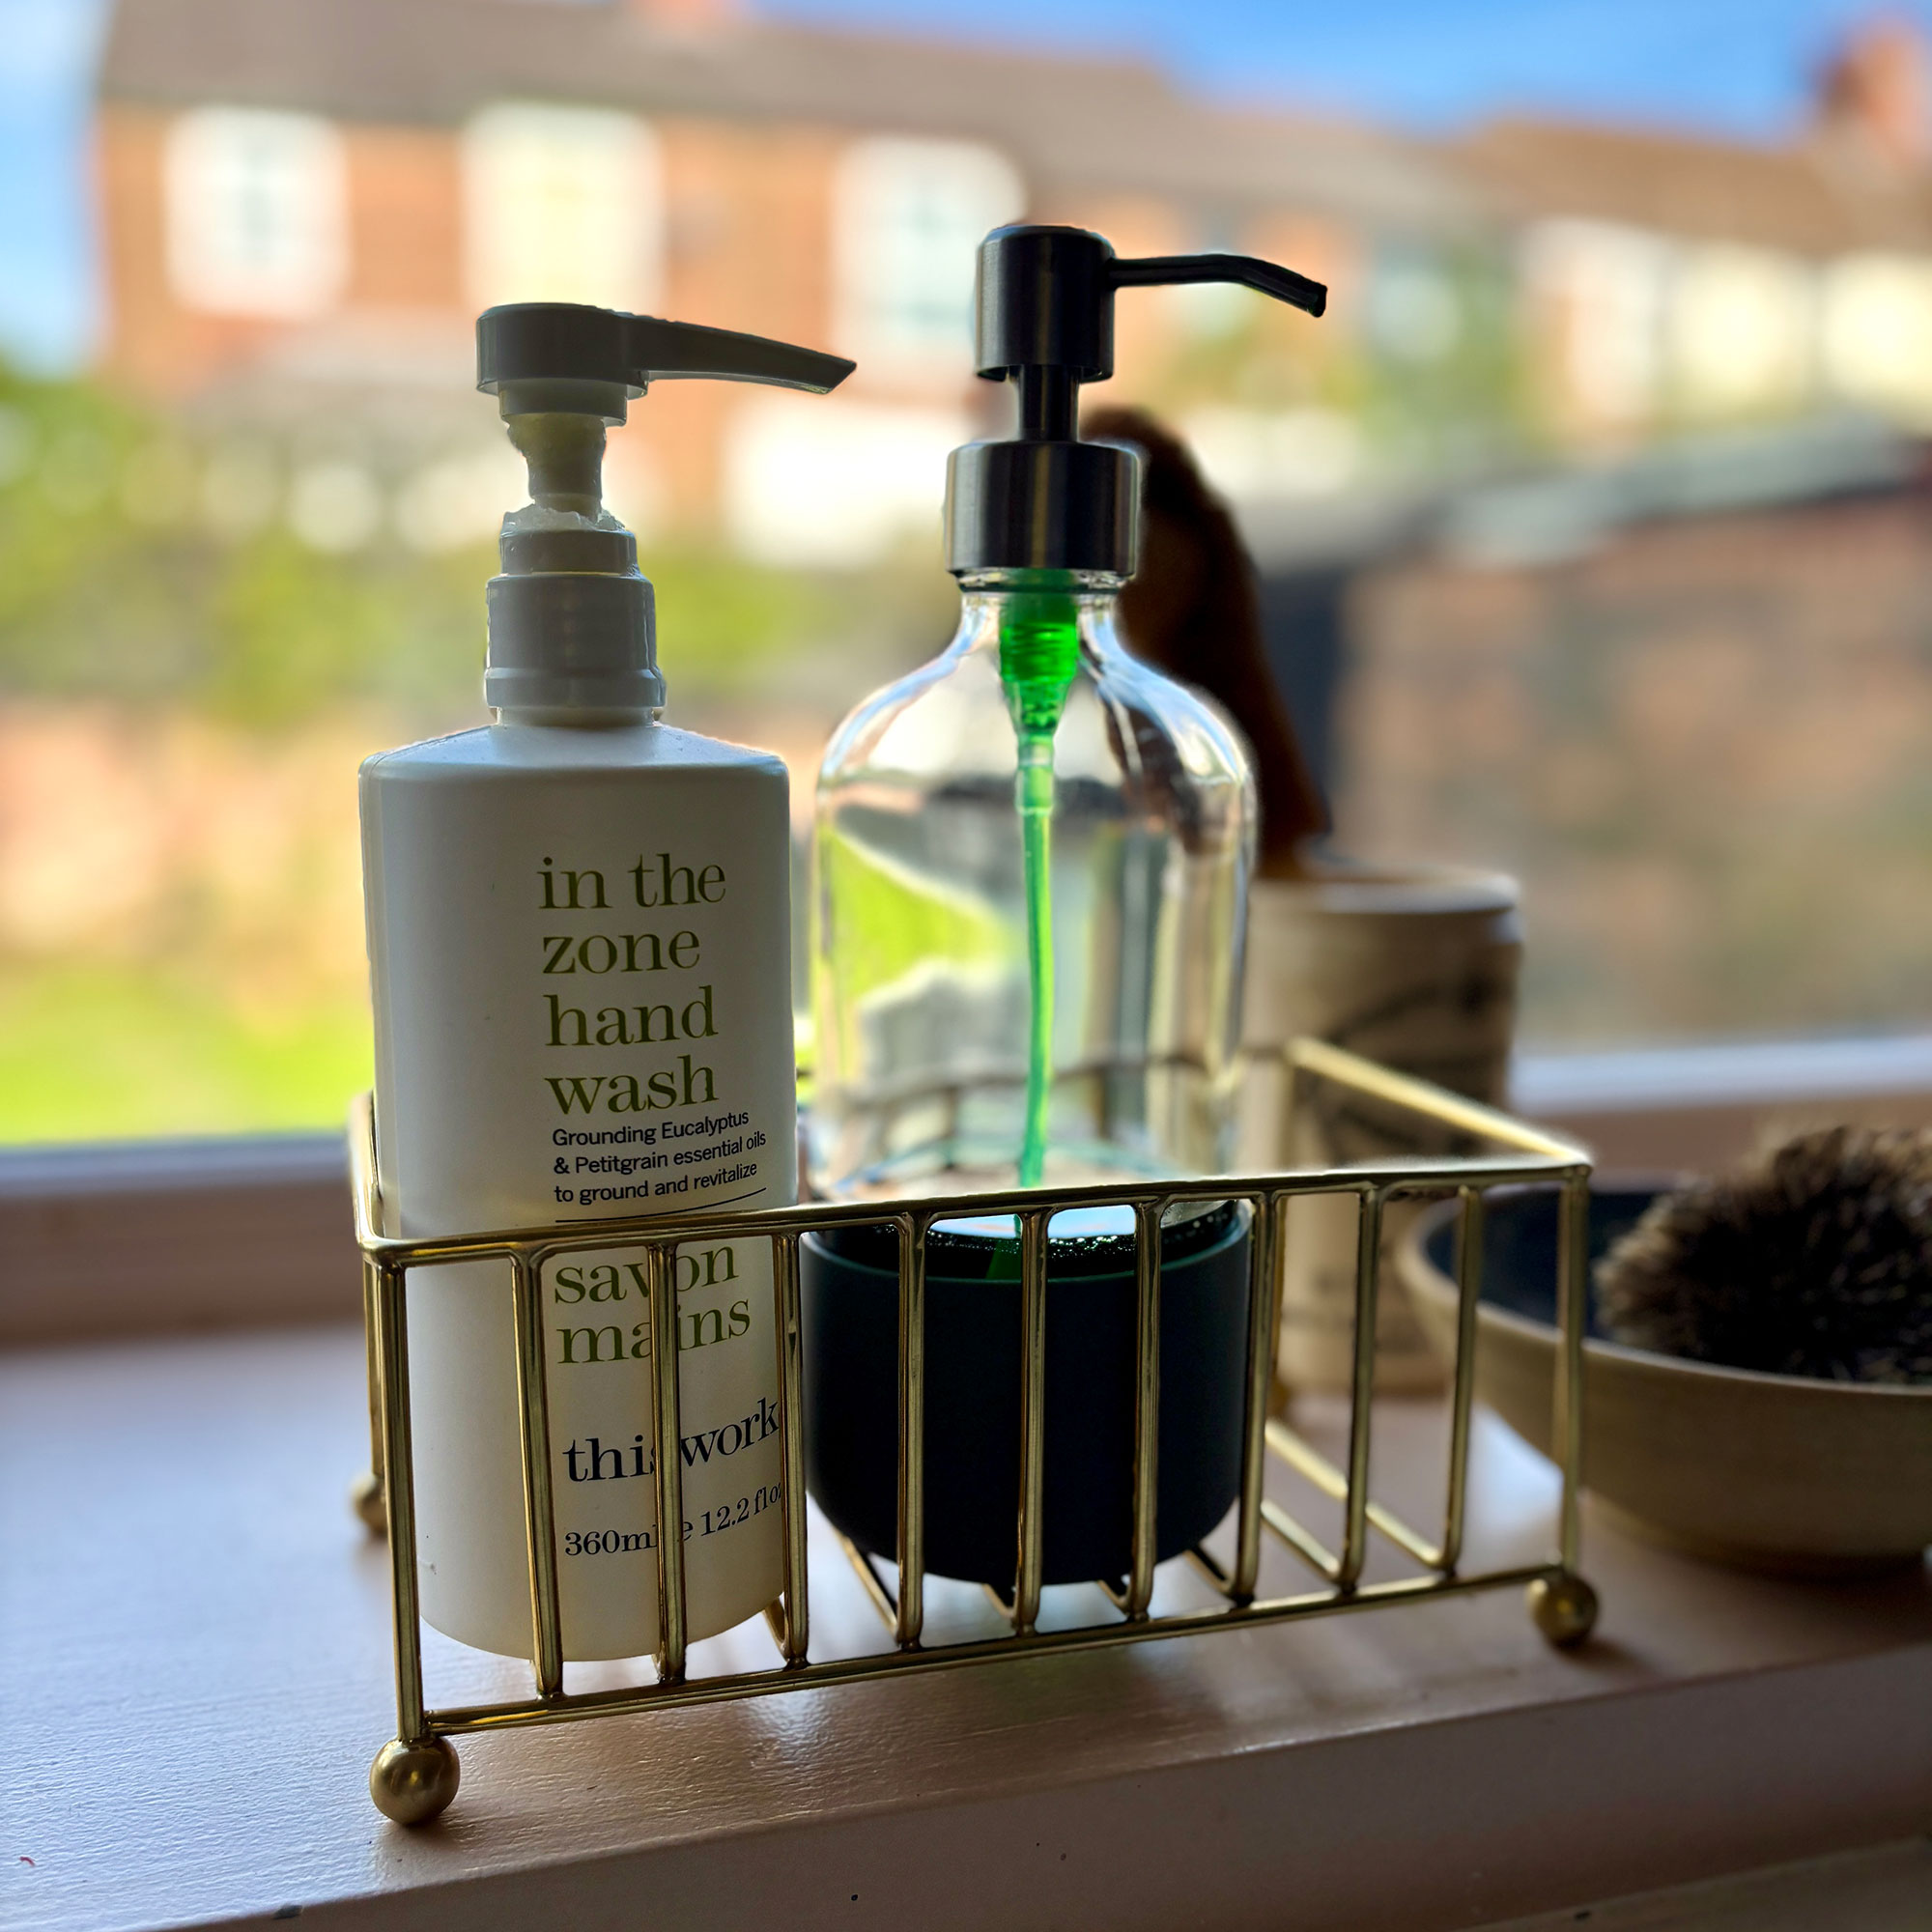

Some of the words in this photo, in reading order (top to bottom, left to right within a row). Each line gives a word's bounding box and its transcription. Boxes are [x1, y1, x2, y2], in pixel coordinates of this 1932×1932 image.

[537, 856, 612, 909] in
[628, 853, 726, 909] the
[542, 930, 700, 975] zone
[542, 984, 719, 1046] hand
[544, 1054, 719, 1115] wash
[553, 1125, 657, 1148] Grounding
[662, 1111, 750, 1139] Eucalyptus
[554, 1157, 570, 1175] &
[576, 1151, 668, 1176] Petitgrain
[673, 1136, 743, 1166] essential
[746, 1130, 766, 1151] oils
[554, 1185, 574, 1203] to
[580, 1180, 649, 1206] ground
[654, 1175, 689, 1195] and
[694, 1161, 758, 1190] revitalize
[700, 1497, 750, 1537] 12.2
